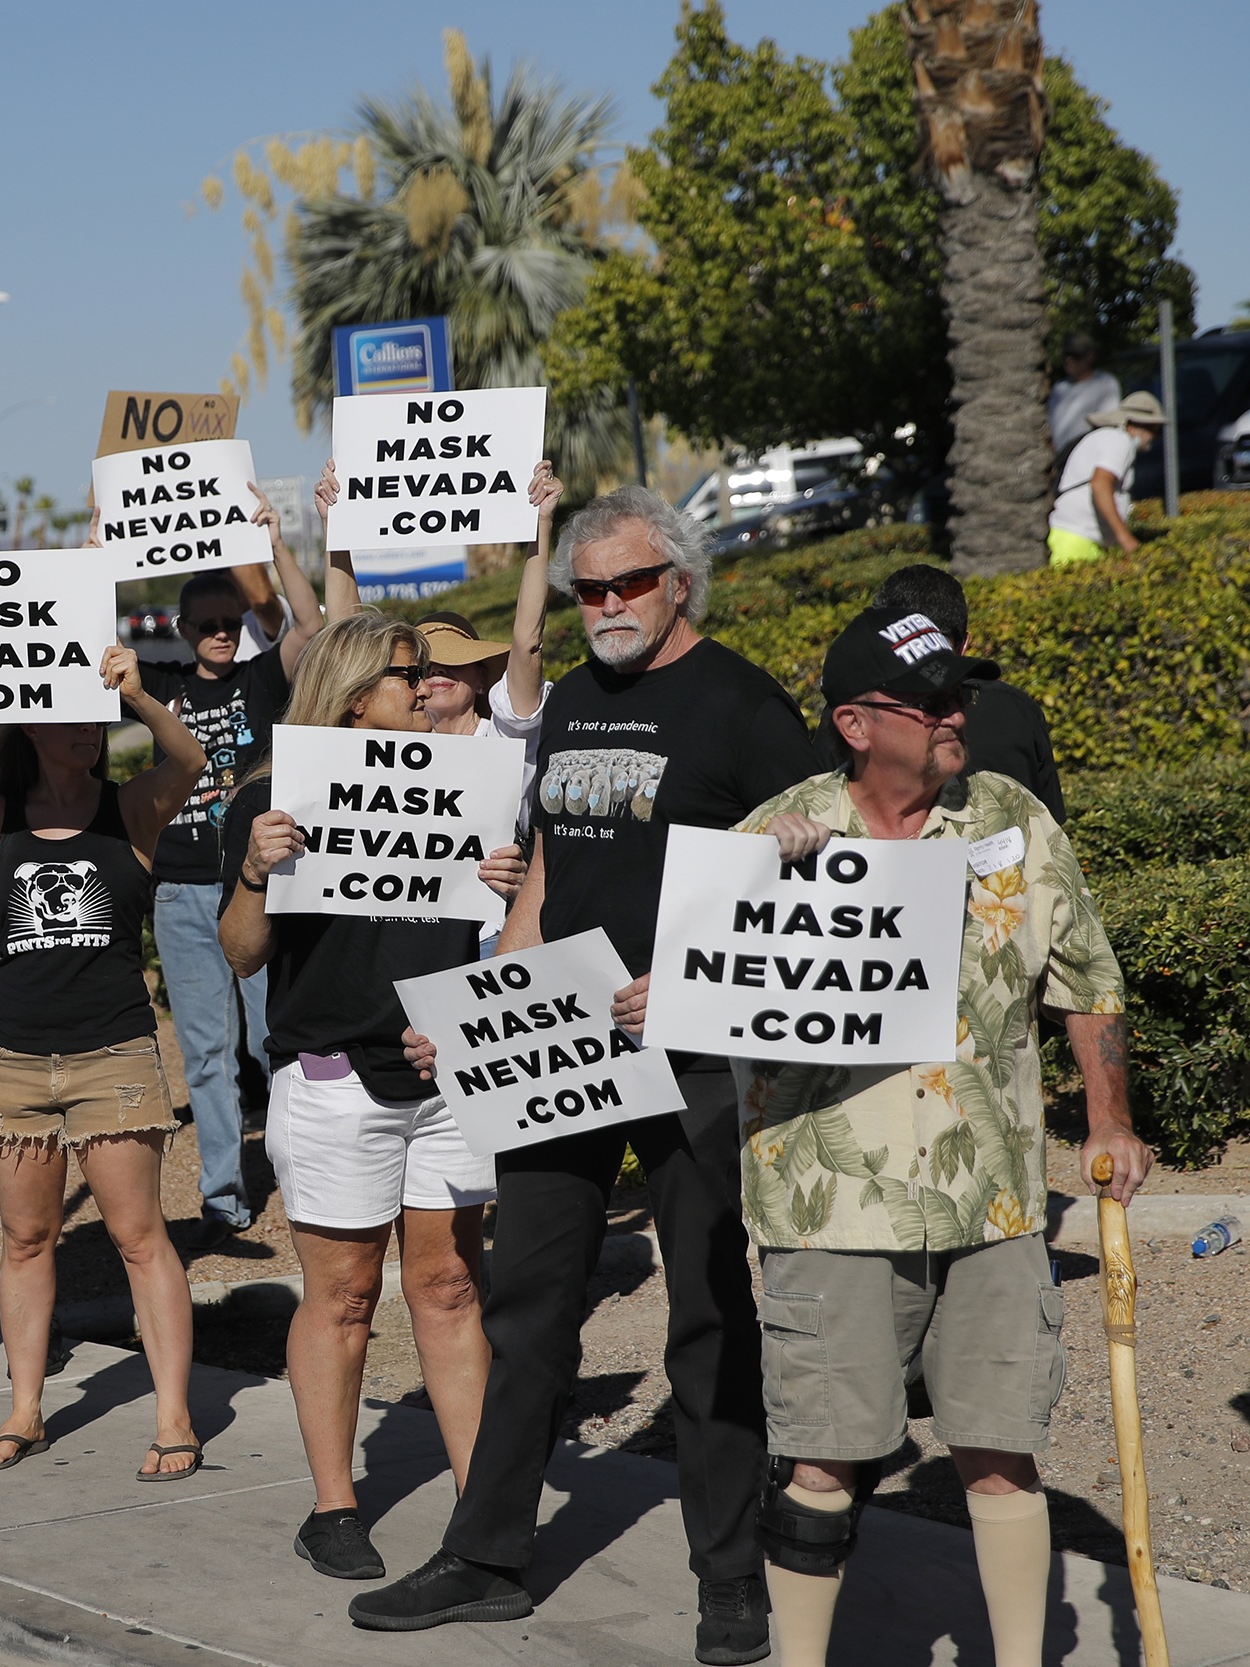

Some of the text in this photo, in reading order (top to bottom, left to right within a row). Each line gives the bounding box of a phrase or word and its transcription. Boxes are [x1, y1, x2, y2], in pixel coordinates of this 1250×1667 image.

[121, 396, 183, 443] NO
[204, 400, 216, 409] NO
[406, 399, 464, 425] NO
[190, 412, 227, 436] VAX
[141, 451, 191, 475] NO
[376, 434, 492, 463] MASK
[122, 477, 221, 508] MASK
[348, 470, 517, 500] NEVADA
[104, 505, 248, 541] NEVADA
[379, 508, 481, 536] .COM
[136, 538, 222, 567] .COM
[894, 631, 953, 666] TRU
[567, 720, 659, 734] It's not a pandemic
[365, 739, 432, 770] NO
[328, 782, 464, 817] MASK
[296, 825, 485, 862] NEVADA
[554, 824, 568, 836] It's
[568, 828, 580, 837] an
[779, 850, 868, 884] NO
[322, 872, 442, 903] .COM
[732, 900, 905, 938] MASK
[7, 933, 110, 954] PINTS FOR PITS
[466, 963, 531, 1000] NO
[683, 947, 930, 992] NEVADA
[459, 993, 591, 1049] MASK
[729, 1008, 883, 1045] .COM
[454, 1028, 641, 1097] NEVADA
[516, 1078, 623, 1130] .COM
